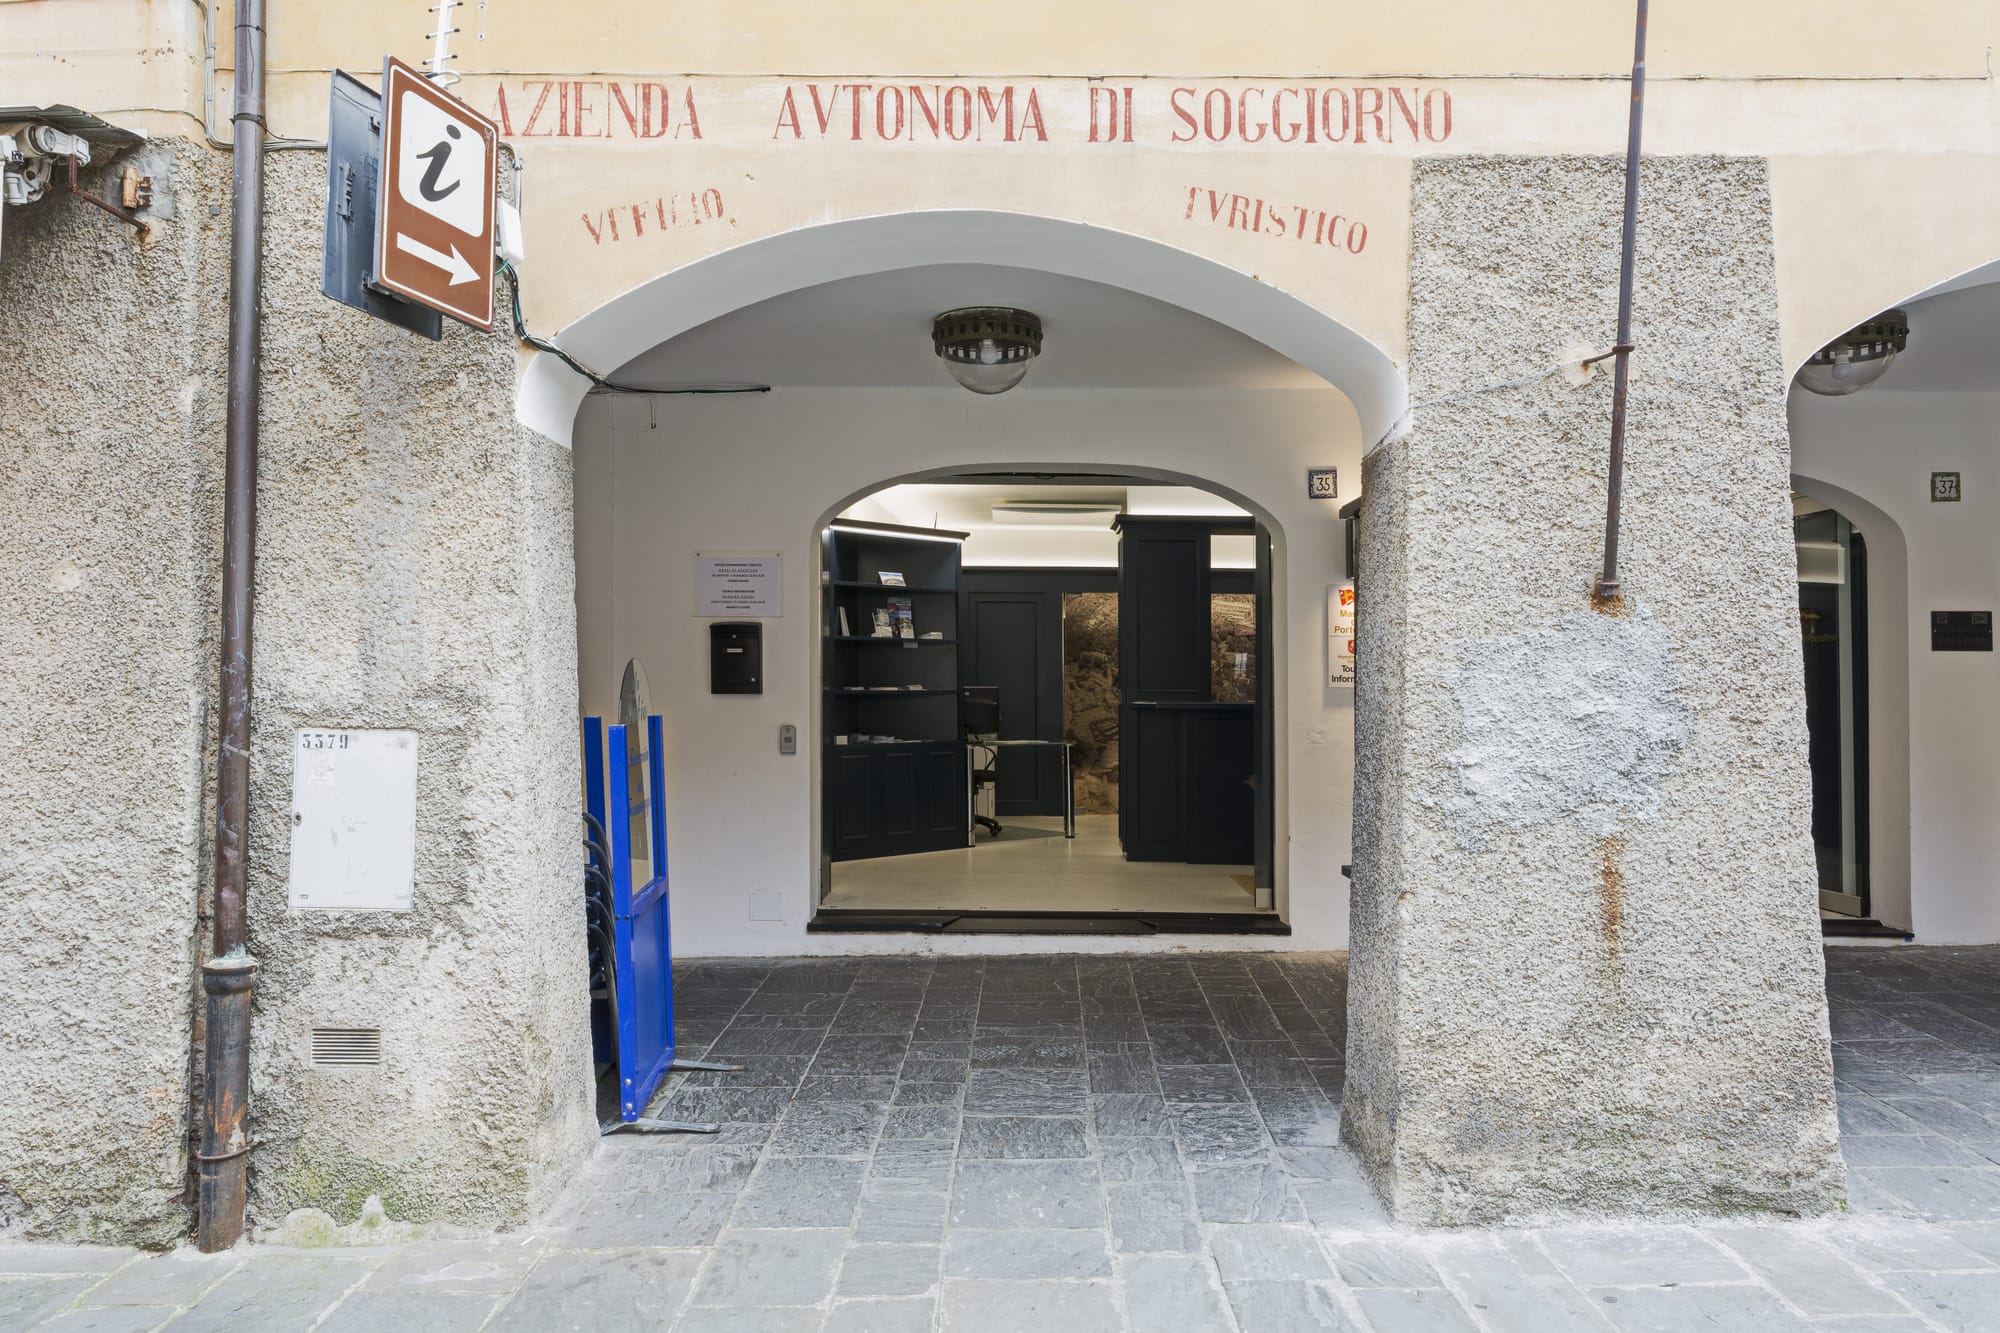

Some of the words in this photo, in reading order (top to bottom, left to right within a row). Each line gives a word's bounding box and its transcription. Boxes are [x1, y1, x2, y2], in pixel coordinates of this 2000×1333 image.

[491, 81, 704, 139] AZIENDA
[1087, 87, 1135, 143] DI
[1172, 87, 1453, 144] SOGGIORNO
[1316, 477, 1331, 492] 35
[1939, 480, 1954, 494] 37
